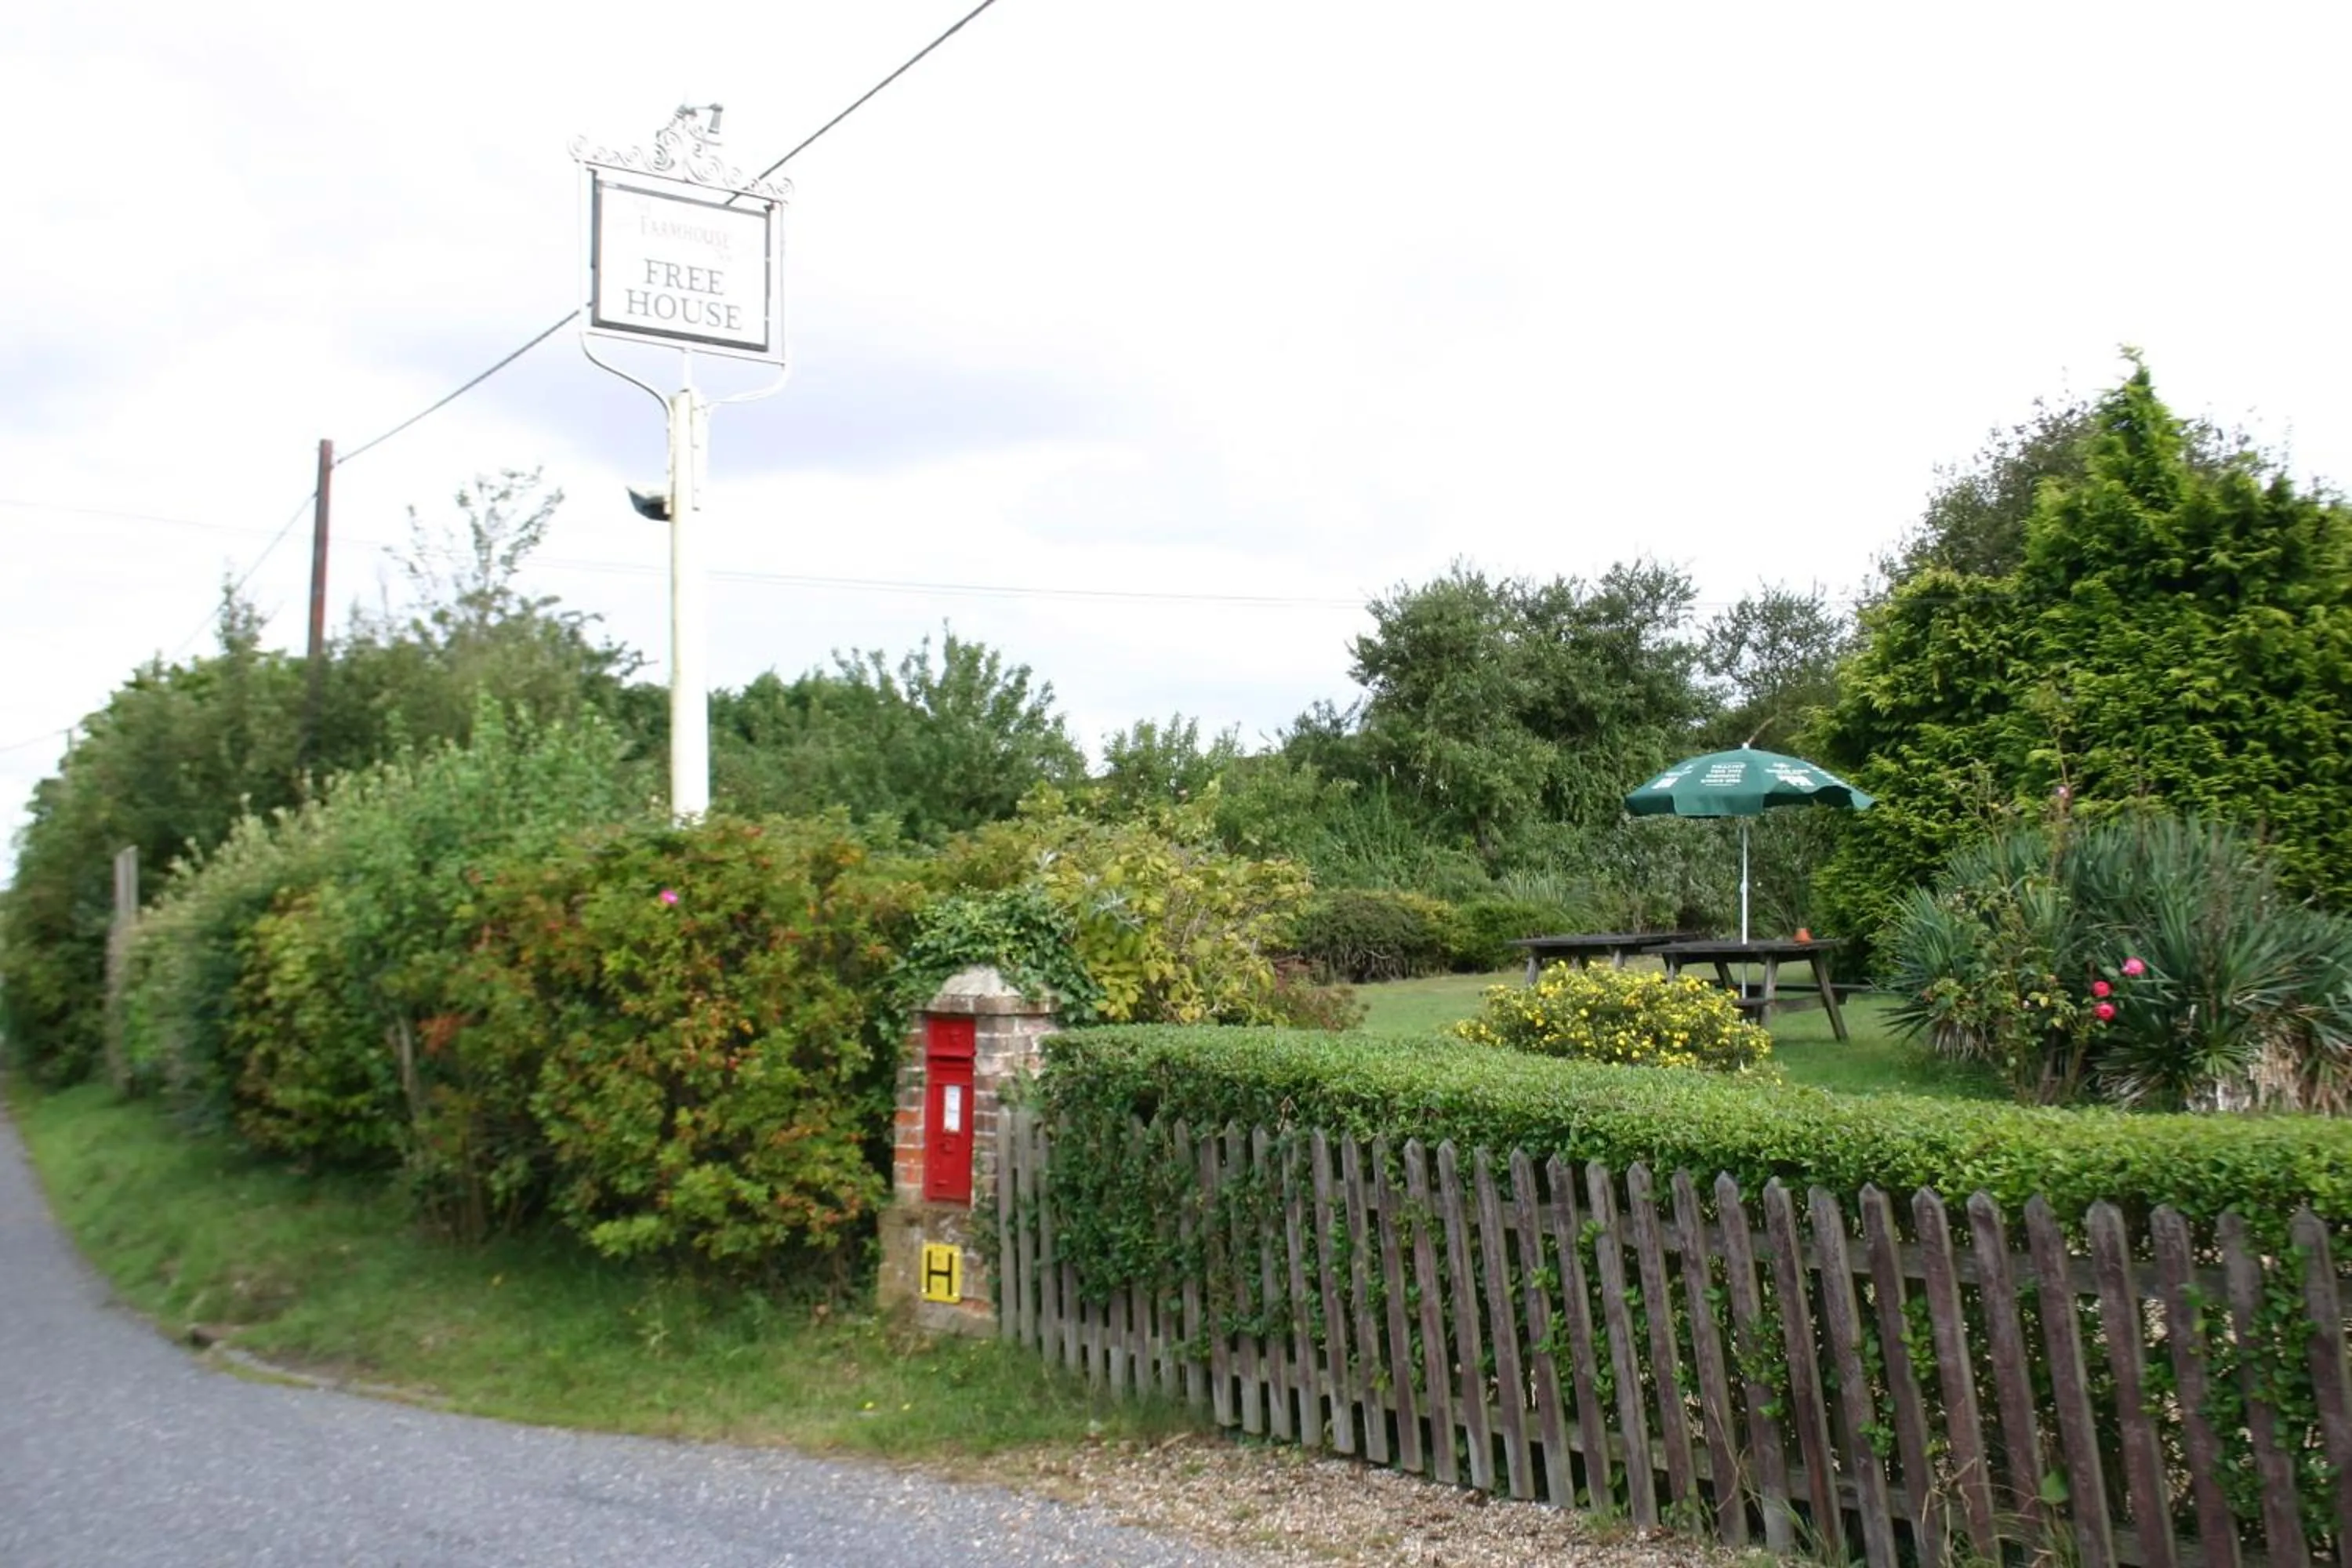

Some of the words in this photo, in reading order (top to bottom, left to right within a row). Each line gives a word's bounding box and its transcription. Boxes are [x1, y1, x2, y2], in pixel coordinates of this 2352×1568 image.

[644, 258, 725, 296] FREE
[626, 289, 742, 330] HOUSE
[927, 1250, 953, 1296] H
